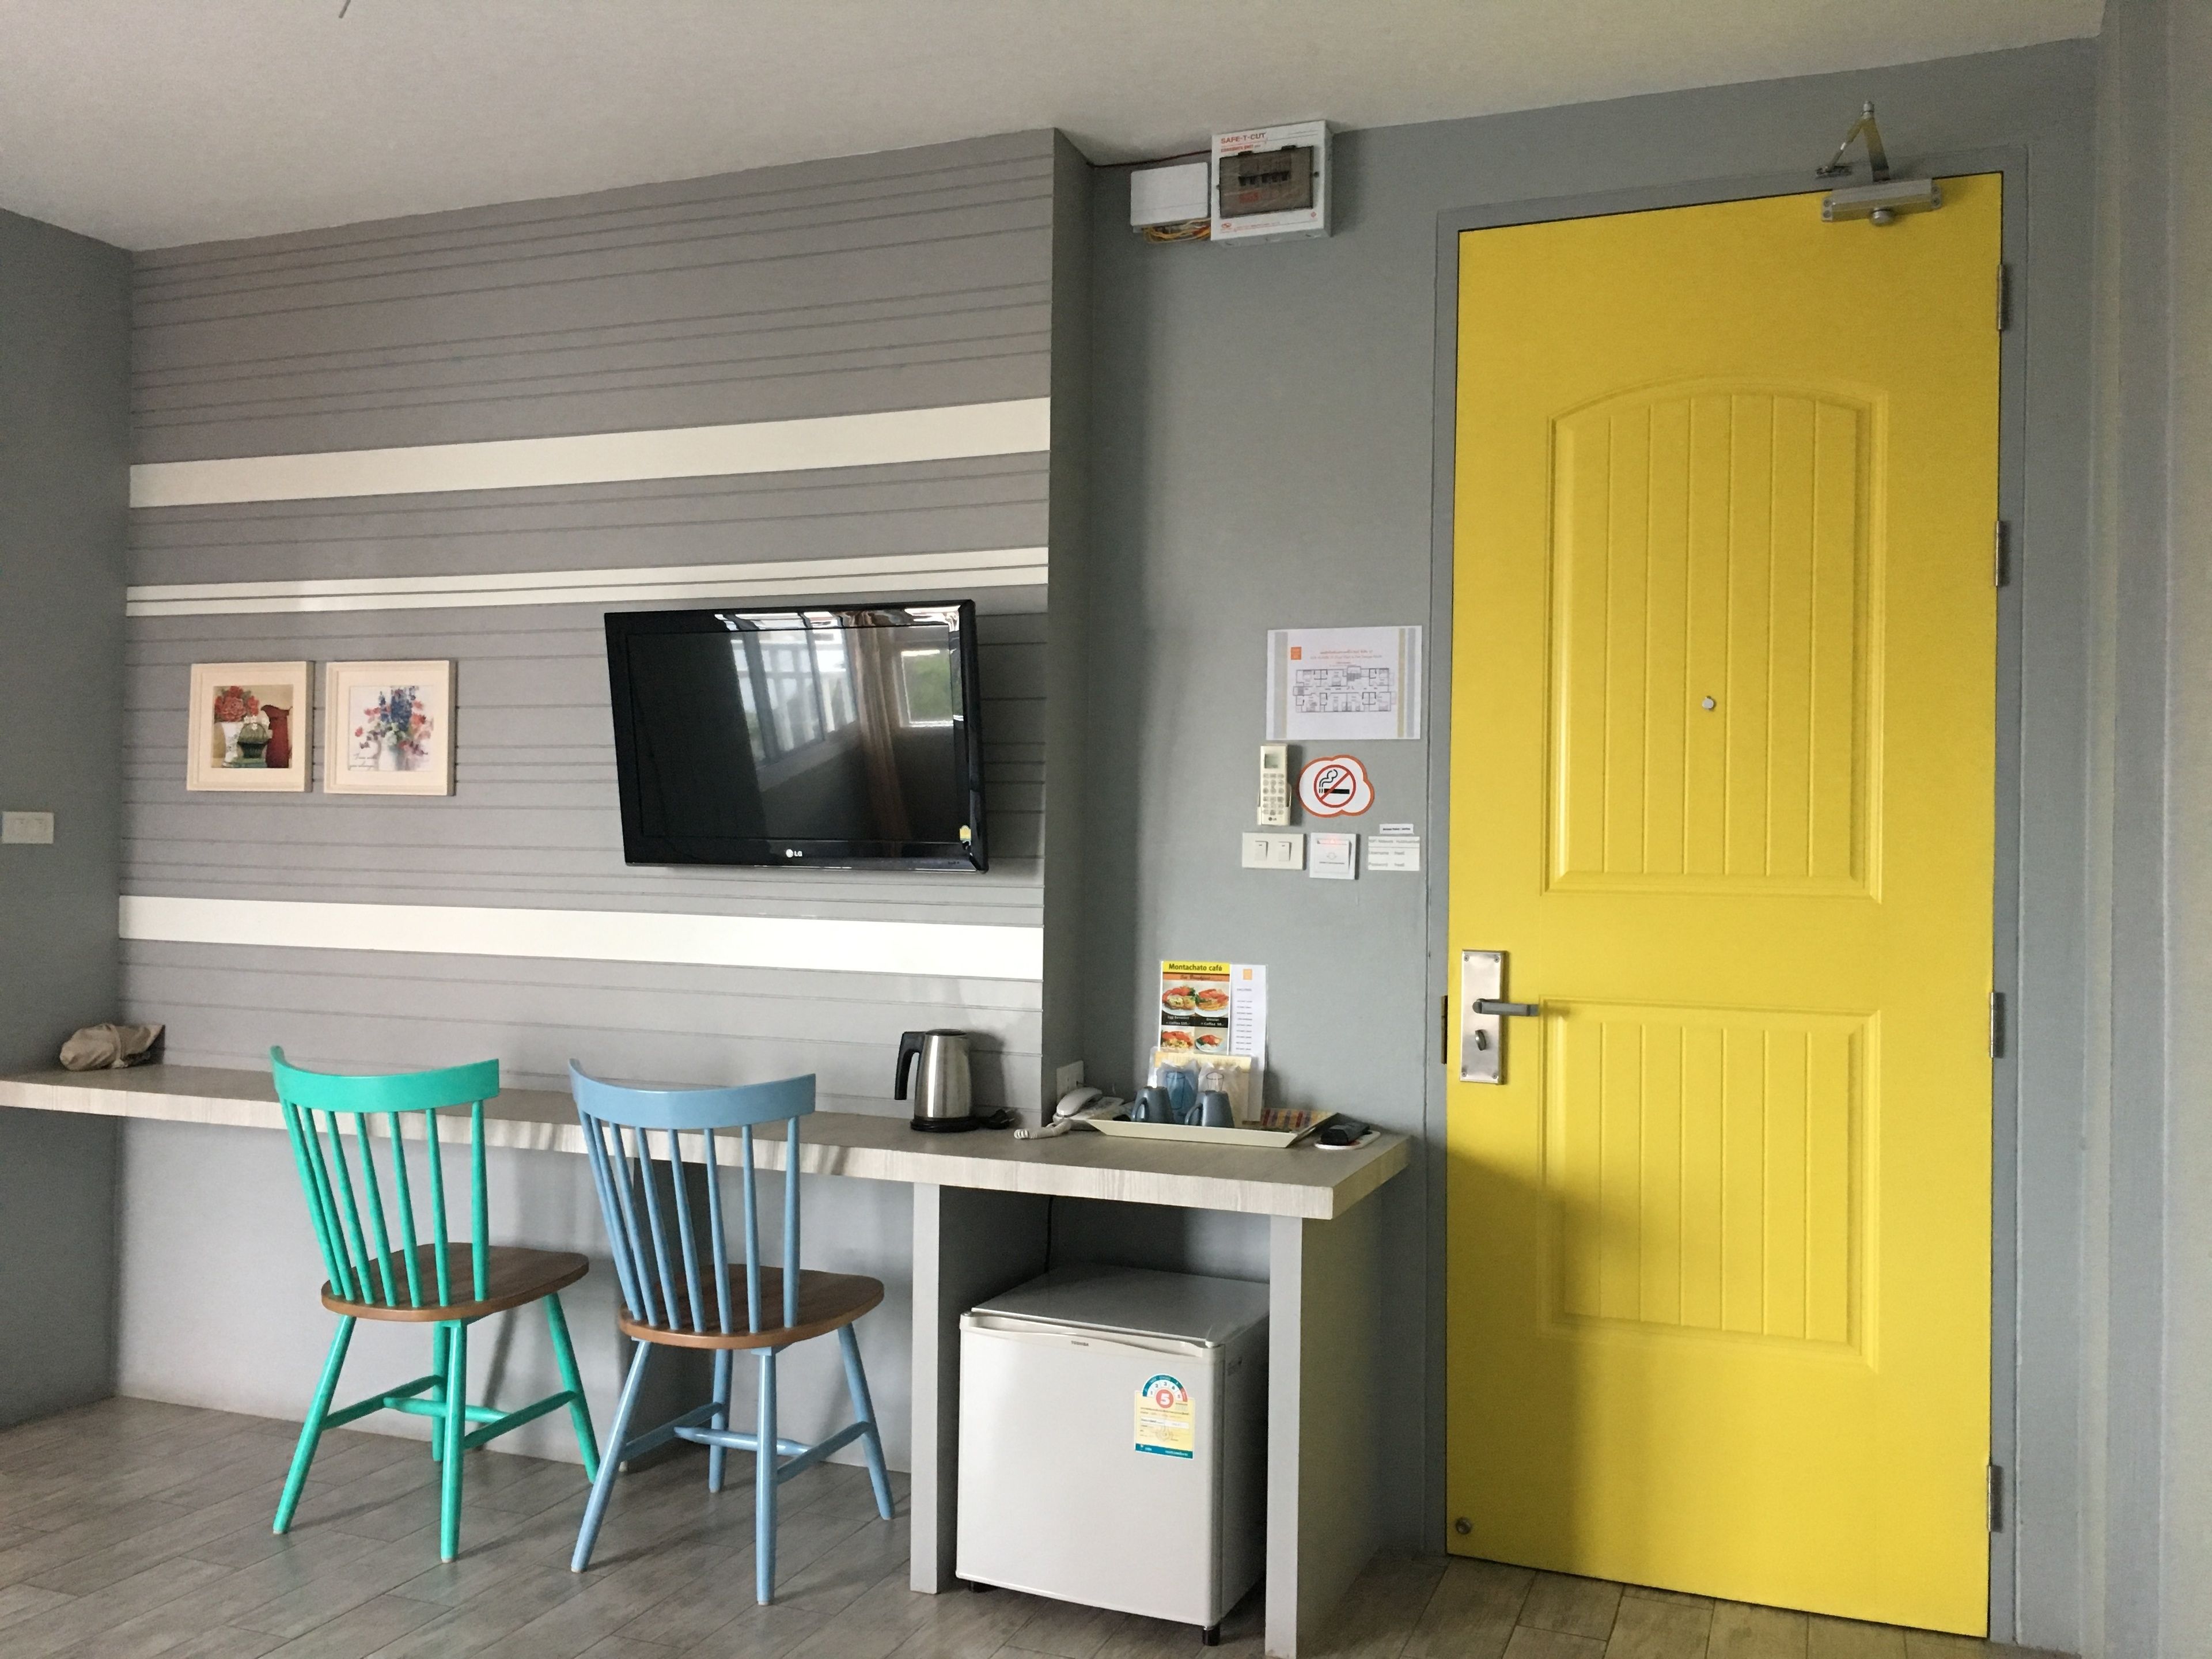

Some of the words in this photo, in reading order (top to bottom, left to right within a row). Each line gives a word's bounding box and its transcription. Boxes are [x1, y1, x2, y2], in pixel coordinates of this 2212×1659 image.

[1221, 132, 1266, 144] SAFE-T-CUT
[1169, 963, 1207, 971] Montachato
[1160, 1393, 1171, 1406] 5
